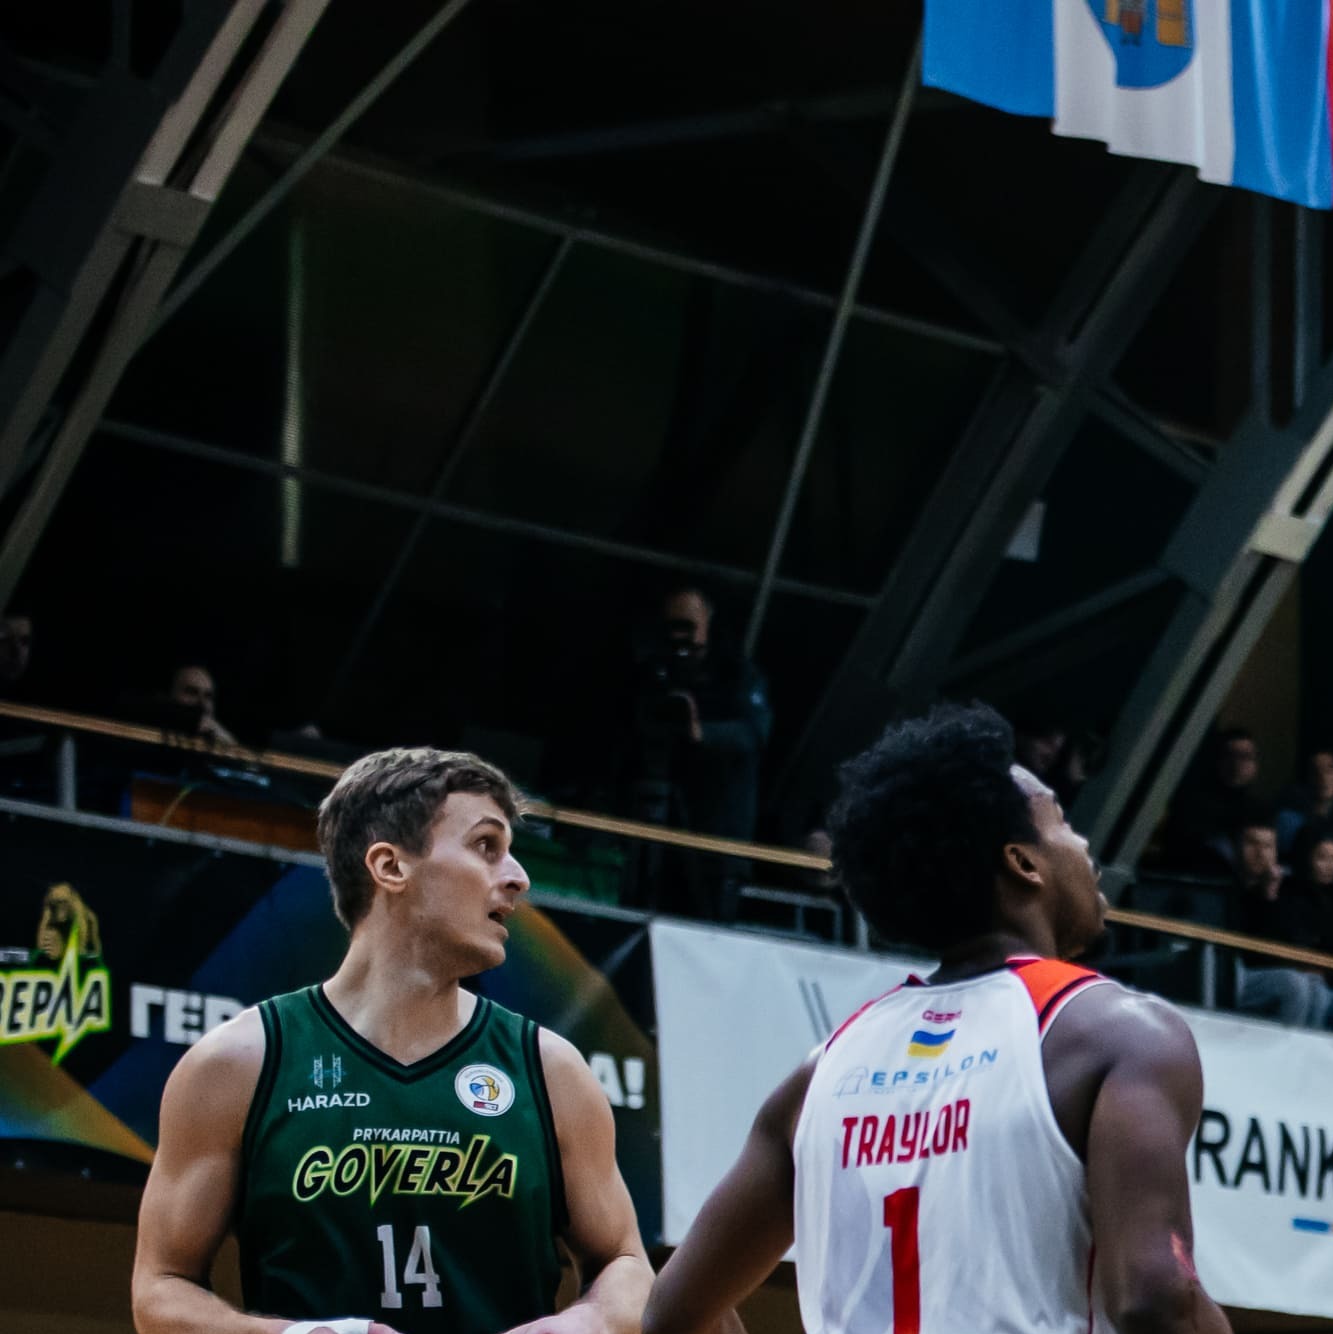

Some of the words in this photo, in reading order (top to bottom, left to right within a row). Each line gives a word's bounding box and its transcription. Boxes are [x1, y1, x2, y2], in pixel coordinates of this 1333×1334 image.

[870, 1049, 998, 1086] EPSILON
[288, 1093, 371, 1113] HARAZD
[353, 1128, 461, 1145] PRYKARPATTIA
[842, 1098, 970, 1170] TRAYLOR
[292, 1134, 518, 1210] GOVERLA
[377, 1224, 443, 1308] 14
